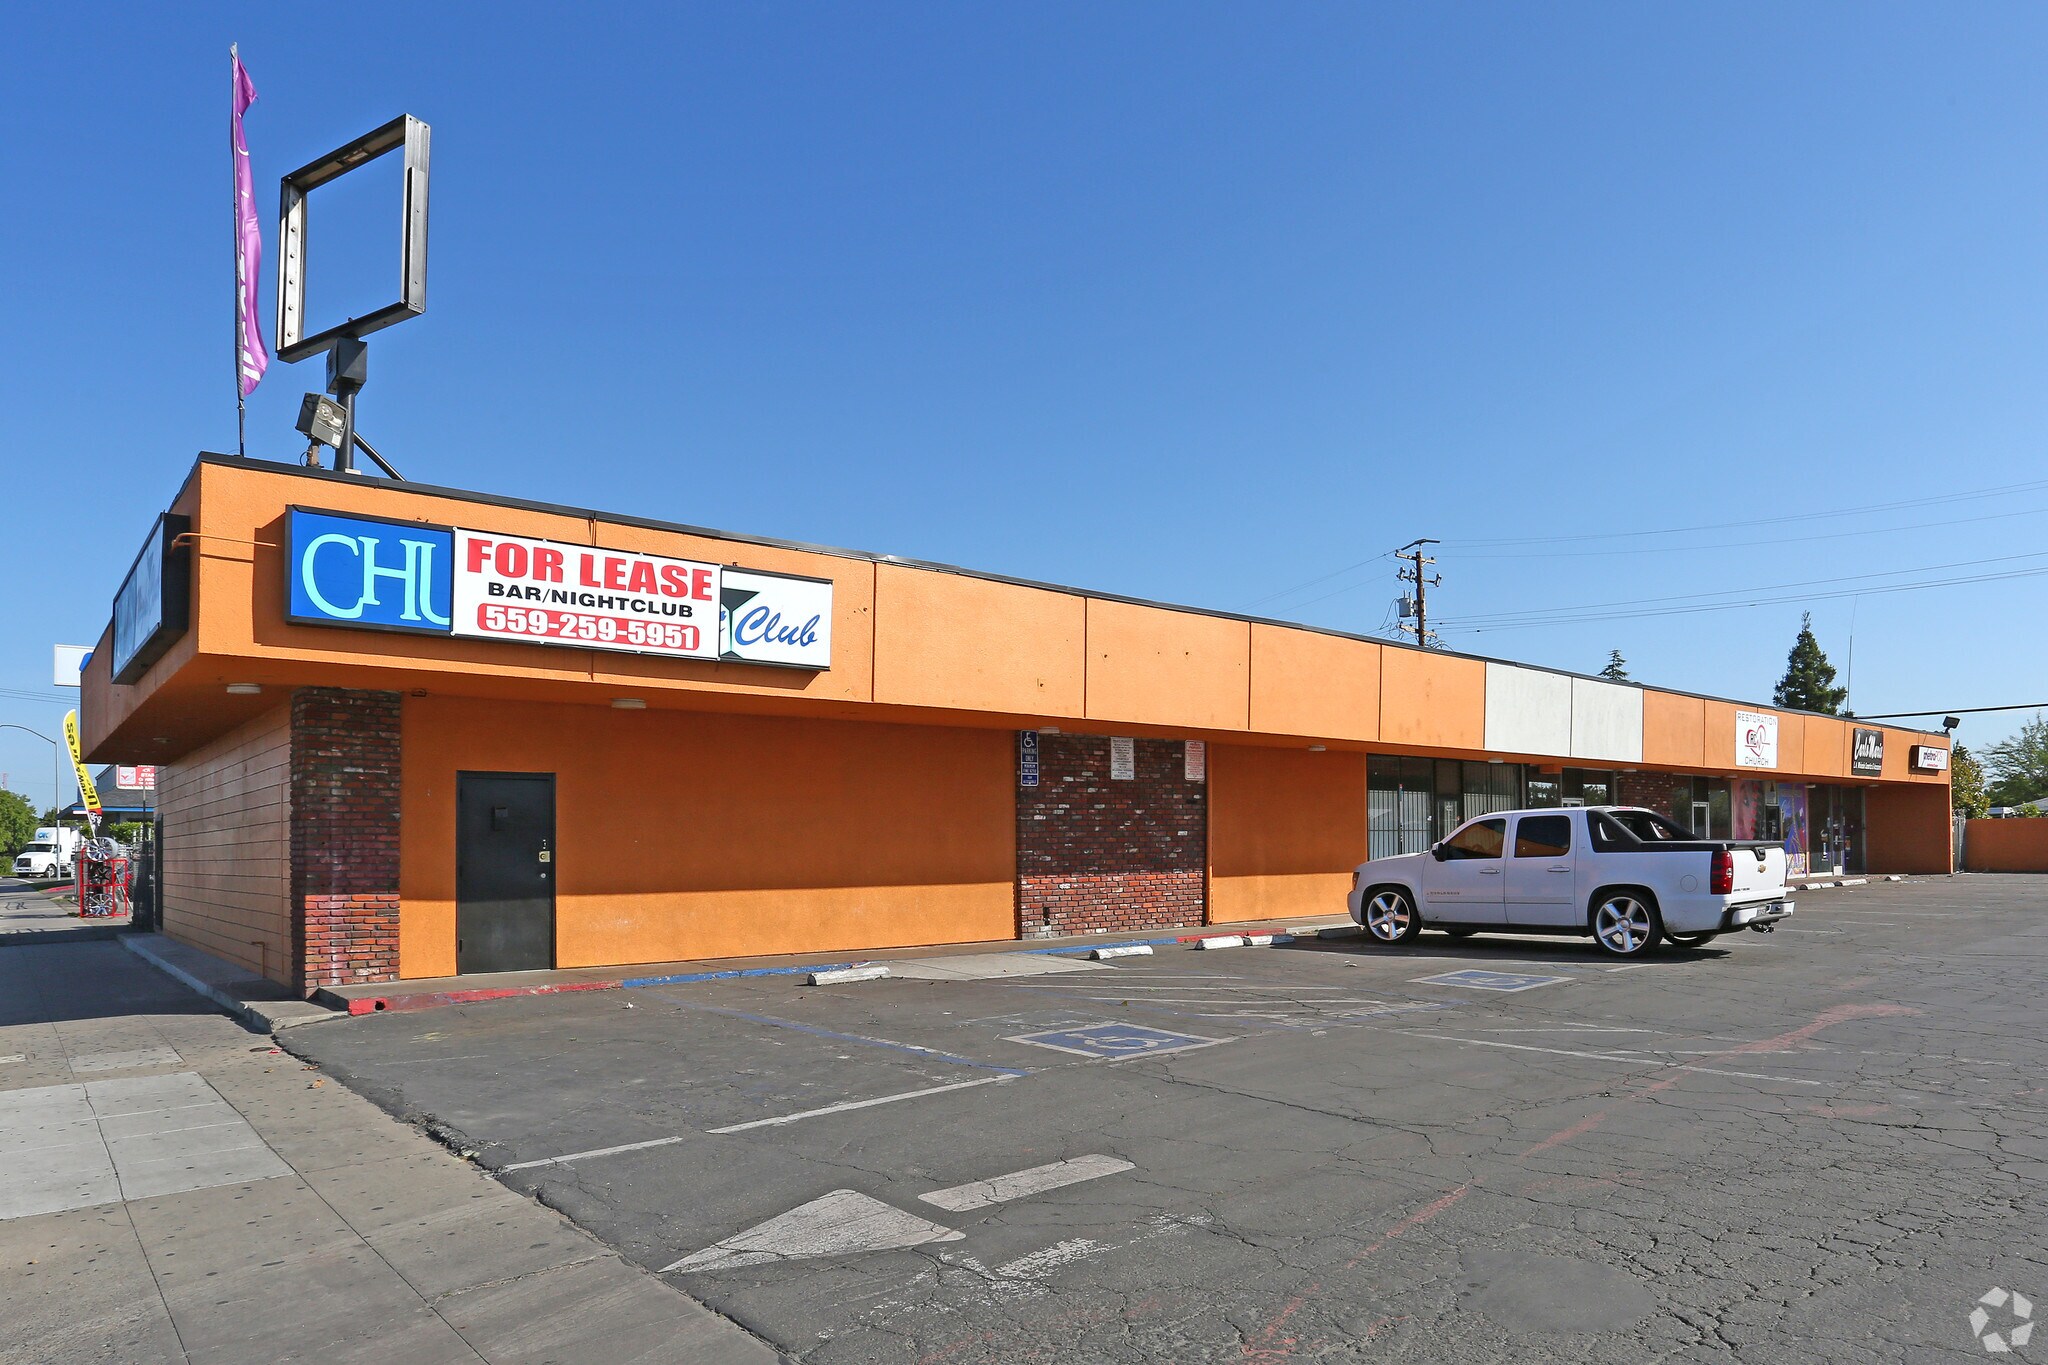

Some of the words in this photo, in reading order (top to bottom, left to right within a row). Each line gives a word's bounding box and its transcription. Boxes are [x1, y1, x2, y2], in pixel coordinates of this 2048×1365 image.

[467, 537, 564, 583] FOR
[579, 553, 713, 602] LEASE
[488, 581, 693, 618] BAR/NIGHTCLUB
[485, 605, 695, 649] 559-259-5951
[734, 605, 821, 647] Club
[1737, 712, 1777, 726] RESTORATION
[1744, 756, 1769, 766] CHURCH
